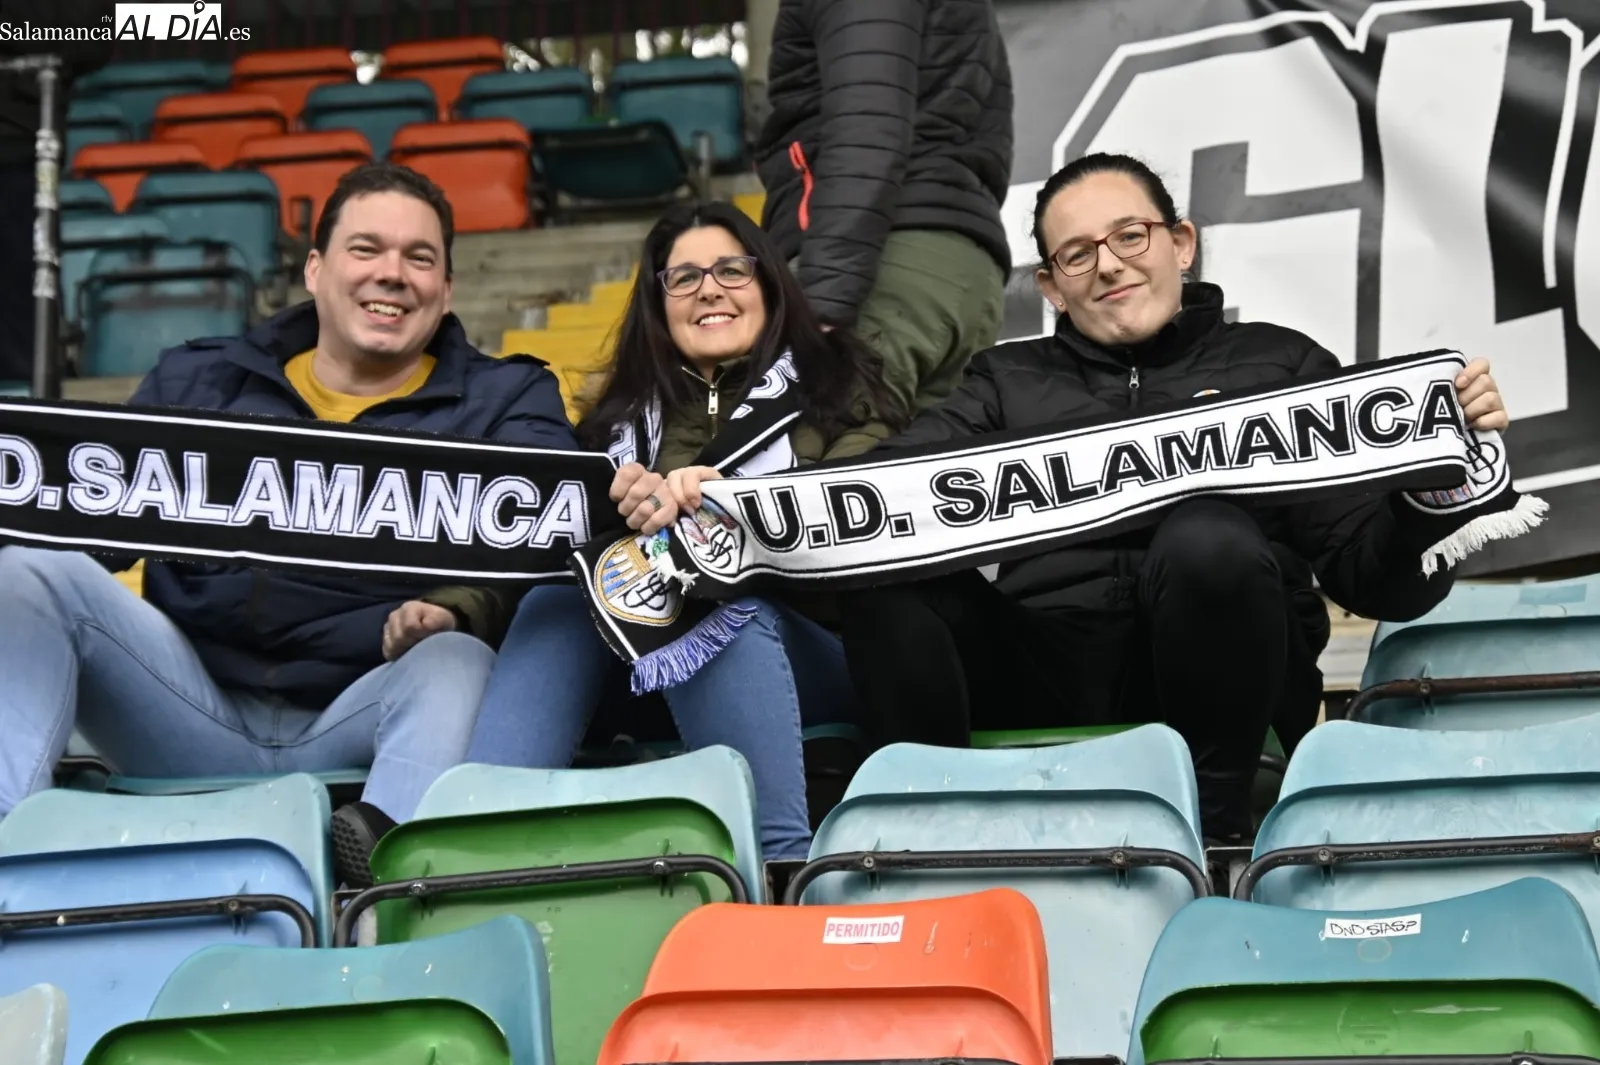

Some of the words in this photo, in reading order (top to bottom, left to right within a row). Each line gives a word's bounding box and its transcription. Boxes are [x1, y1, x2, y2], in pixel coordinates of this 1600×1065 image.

[734, 480, 915, 553] U.D.
[930, 379, 1465, 527] SALAMANCA
[826, 921, 900, 938] PERMITIDO
